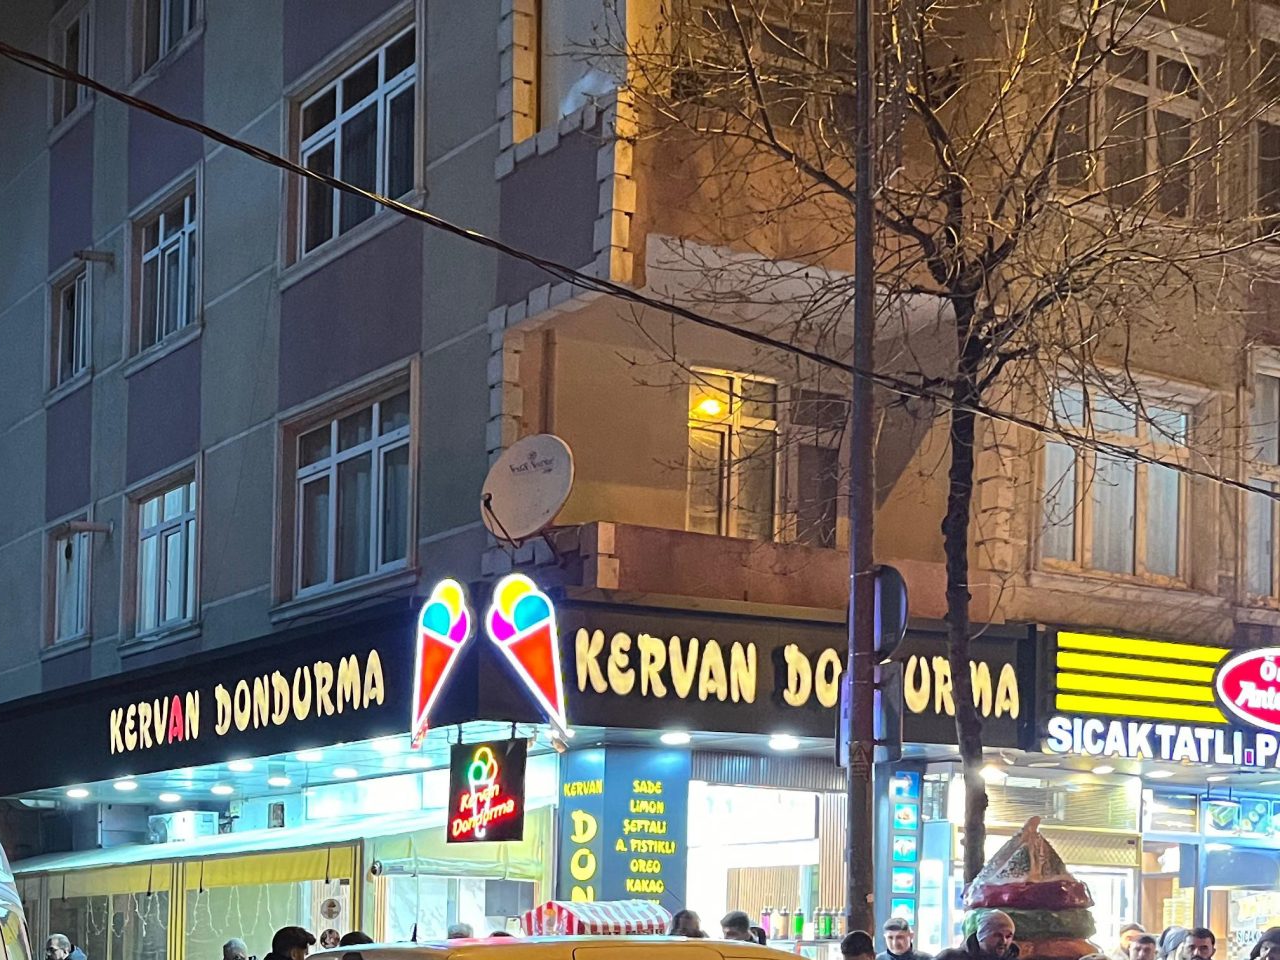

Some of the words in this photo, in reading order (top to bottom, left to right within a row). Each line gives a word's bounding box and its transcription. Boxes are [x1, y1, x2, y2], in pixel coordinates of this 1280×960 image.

[575, 627, 757, 704] KERVAN
[783, 643, 1020, 719] DOURMA
[110, 689, 200, 755] KERVAN
[214, 649, 385, 736] DONDURMA
[563, 779, 603, 797] KERVAN
[632, 779, 663, 794] SADE
